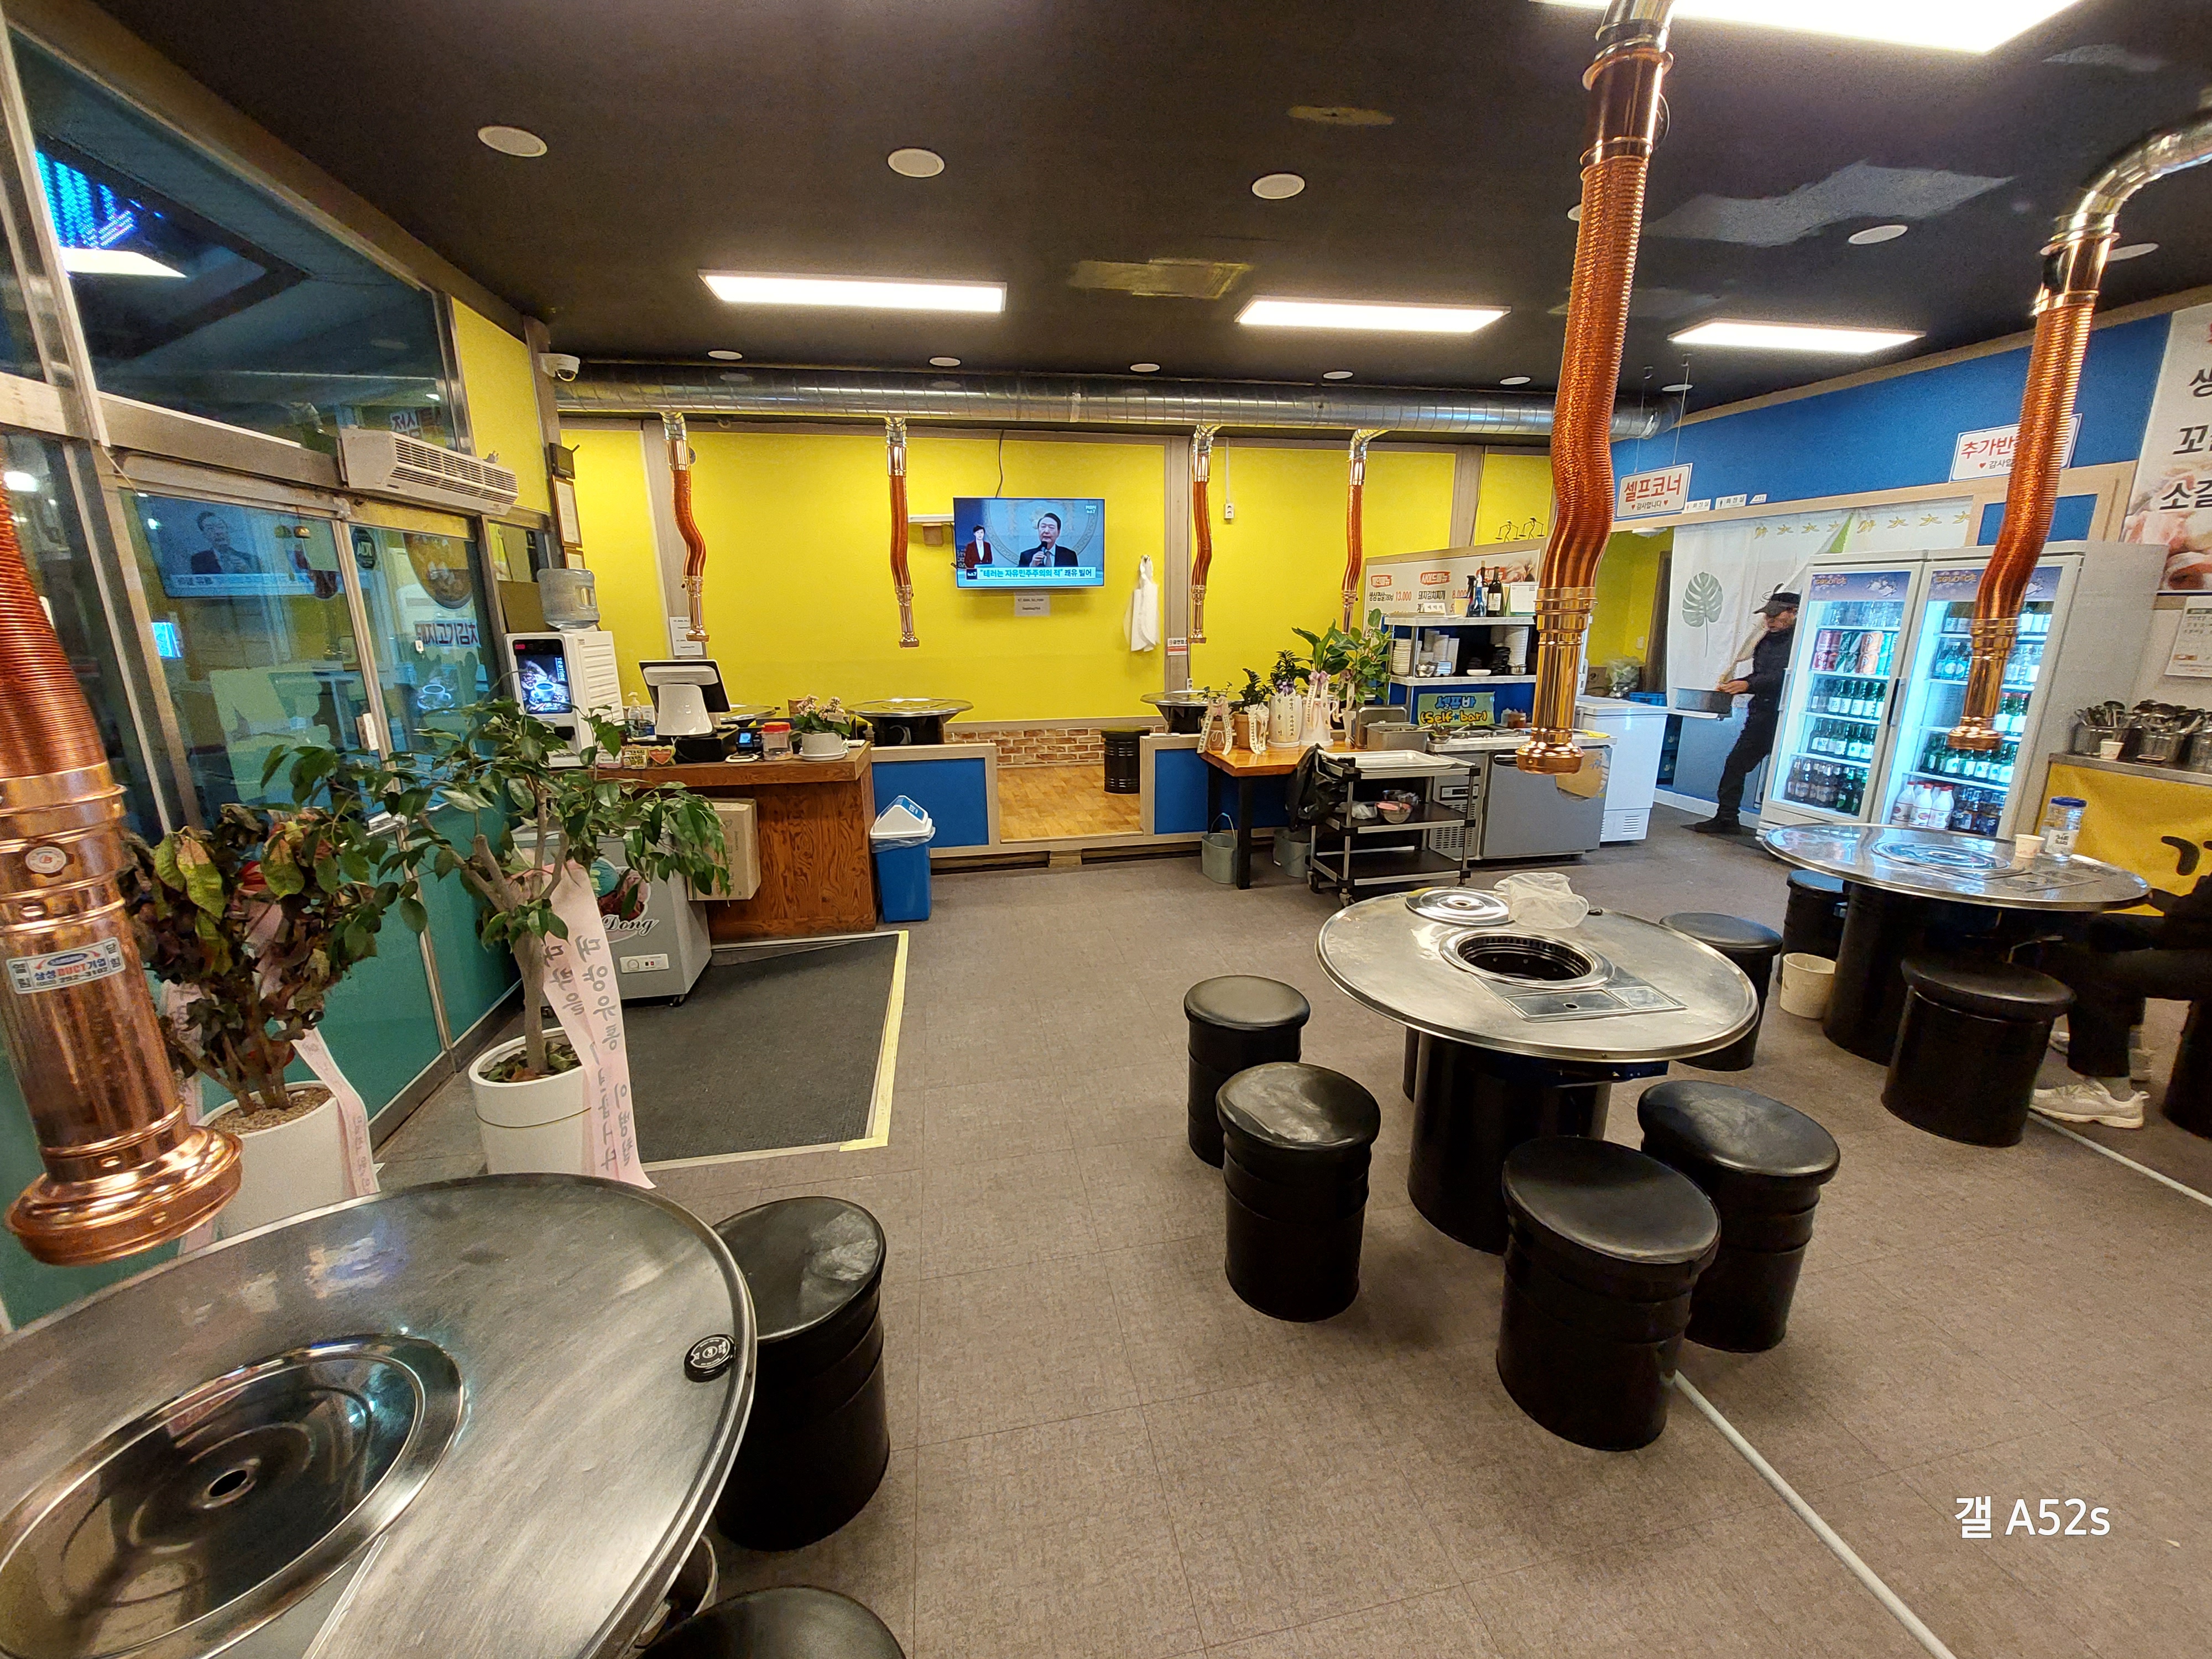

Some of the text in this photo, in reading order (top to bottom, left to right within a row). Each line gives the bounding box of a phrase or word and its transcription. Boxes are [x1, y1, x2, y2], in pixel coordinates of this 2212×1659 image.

[1624, 473, 1682, 503] 셀프코너
[1636, 500, 1662, 510] 감사합니다
[1005, 568, 1052, 578] 자유민주주의의
[1064, 568, 1077, 577] 쾌유
[1079, 568, 1092, 577] 빌어
[1395, 591, 1412, 601] 13,000
[1435, 696, 1476, 710] 셀프바
[602, 914, 660, 936] Dong
